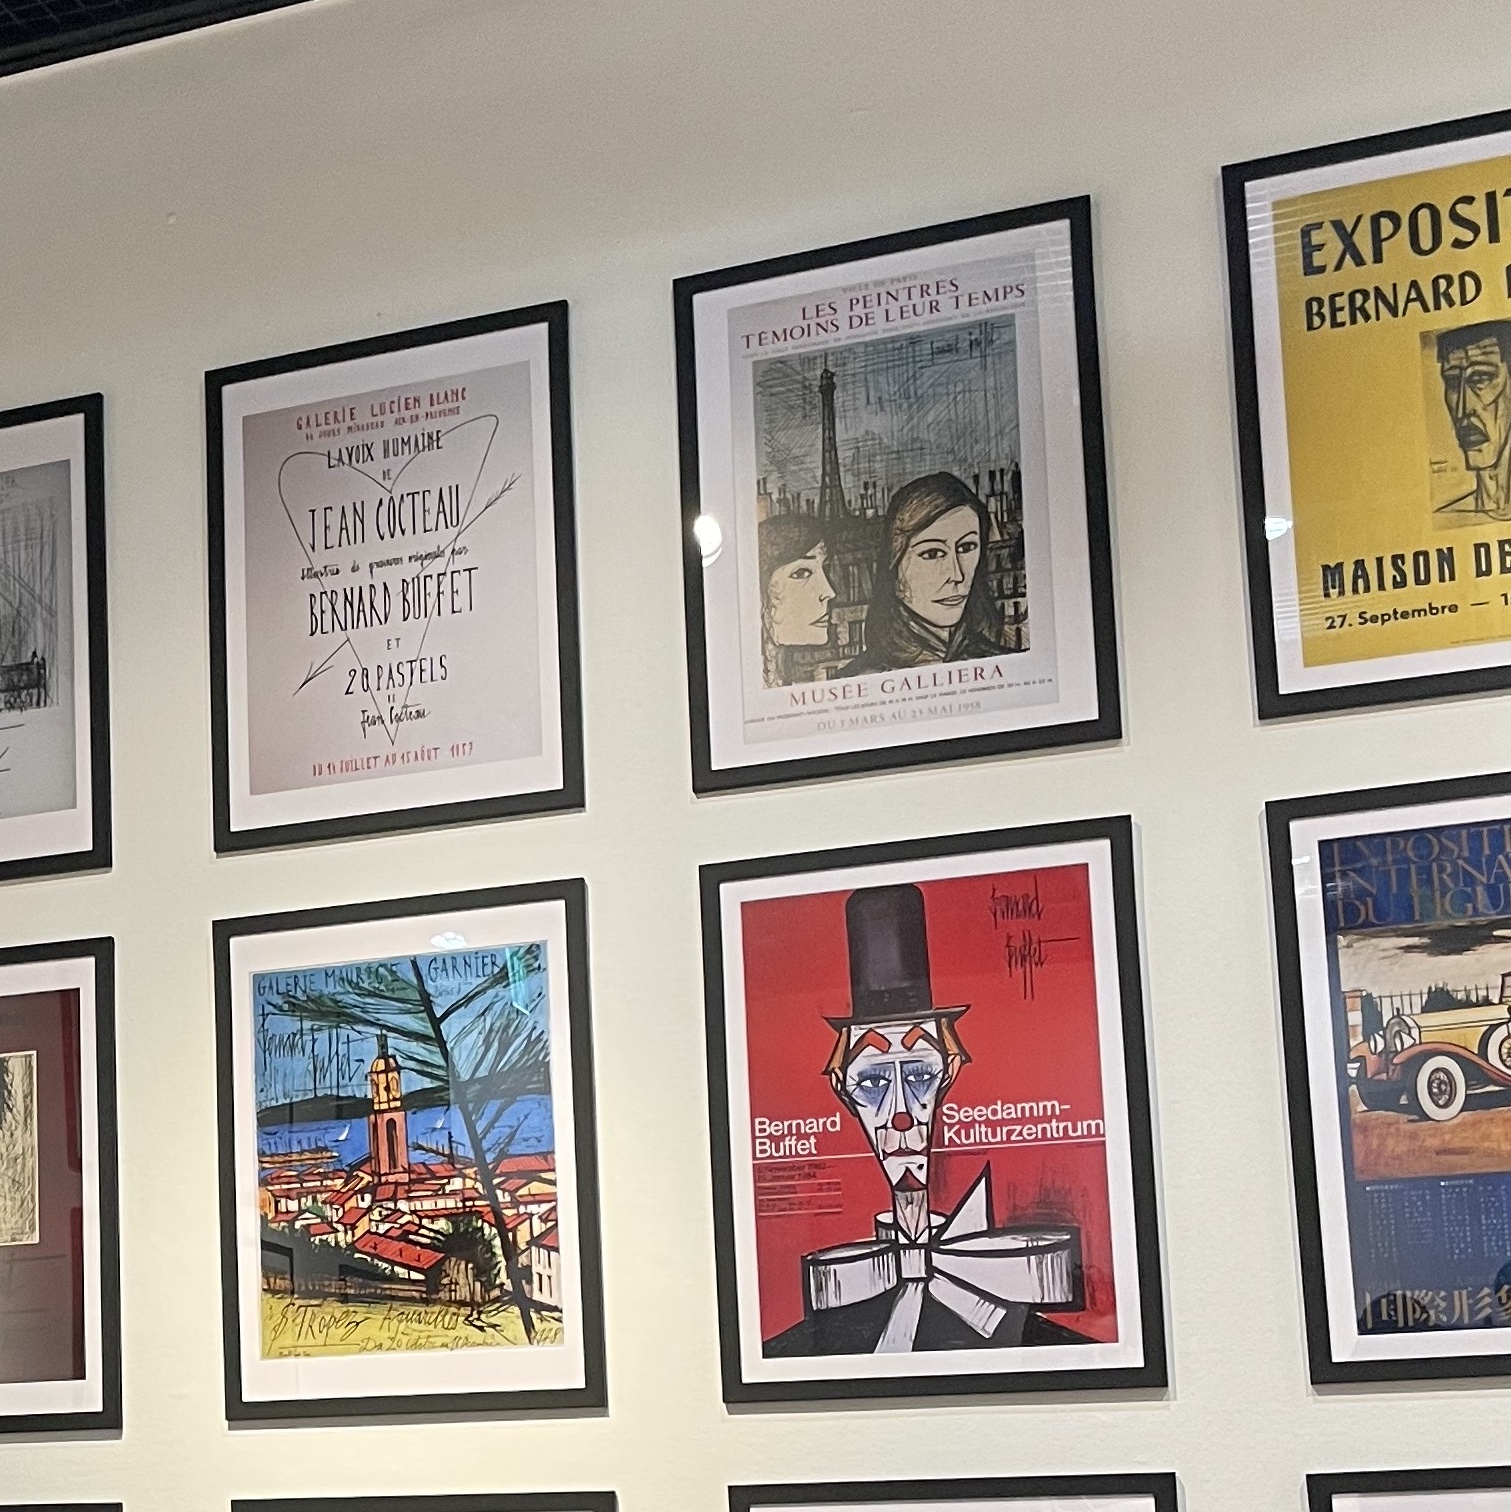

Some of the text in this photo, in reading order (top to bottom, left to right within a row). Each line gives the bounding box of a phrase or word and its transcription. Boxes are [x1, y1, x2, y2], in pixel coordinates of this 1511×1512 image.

[801, 302, 838, 320] LES
[849, 278, 958, 312] PEINTRES
[848, 312, 876, 330] DE
[884, 300, 940, 323] LEUR
[951, 282, 1026, 310] TEMPS
[1305, 270, 1482, 332] BERNARD
[297, 386, 466, 430] GALERIE LUCIEN BLANC
[383, 427, 444, 460] HUMAINE
[308, 484, 460, 552] JEAN COCTEAU
[1320, 546, 1456, 598] MAISON
[309, 567, 478, 636] BERNARD BUFFET
[1325, 602, 1458, 630] 27. Septembre
[387, 638, 402, 650] ET
[376, 654, 448, 691] PASTELS
[880, 664, 1004, 694] GALLIERA
[258, 974, 316, 996] GALERIE
[428, 950, 500, 983] GARNIER
[754, 1112, 841, 1138] Bernard
[942, 1100, 1070, 1124] Seedamm-
[755, 1134, 817, 1158] Buffet
[943, 1118, 1104, 1145] Kulturzentrum
